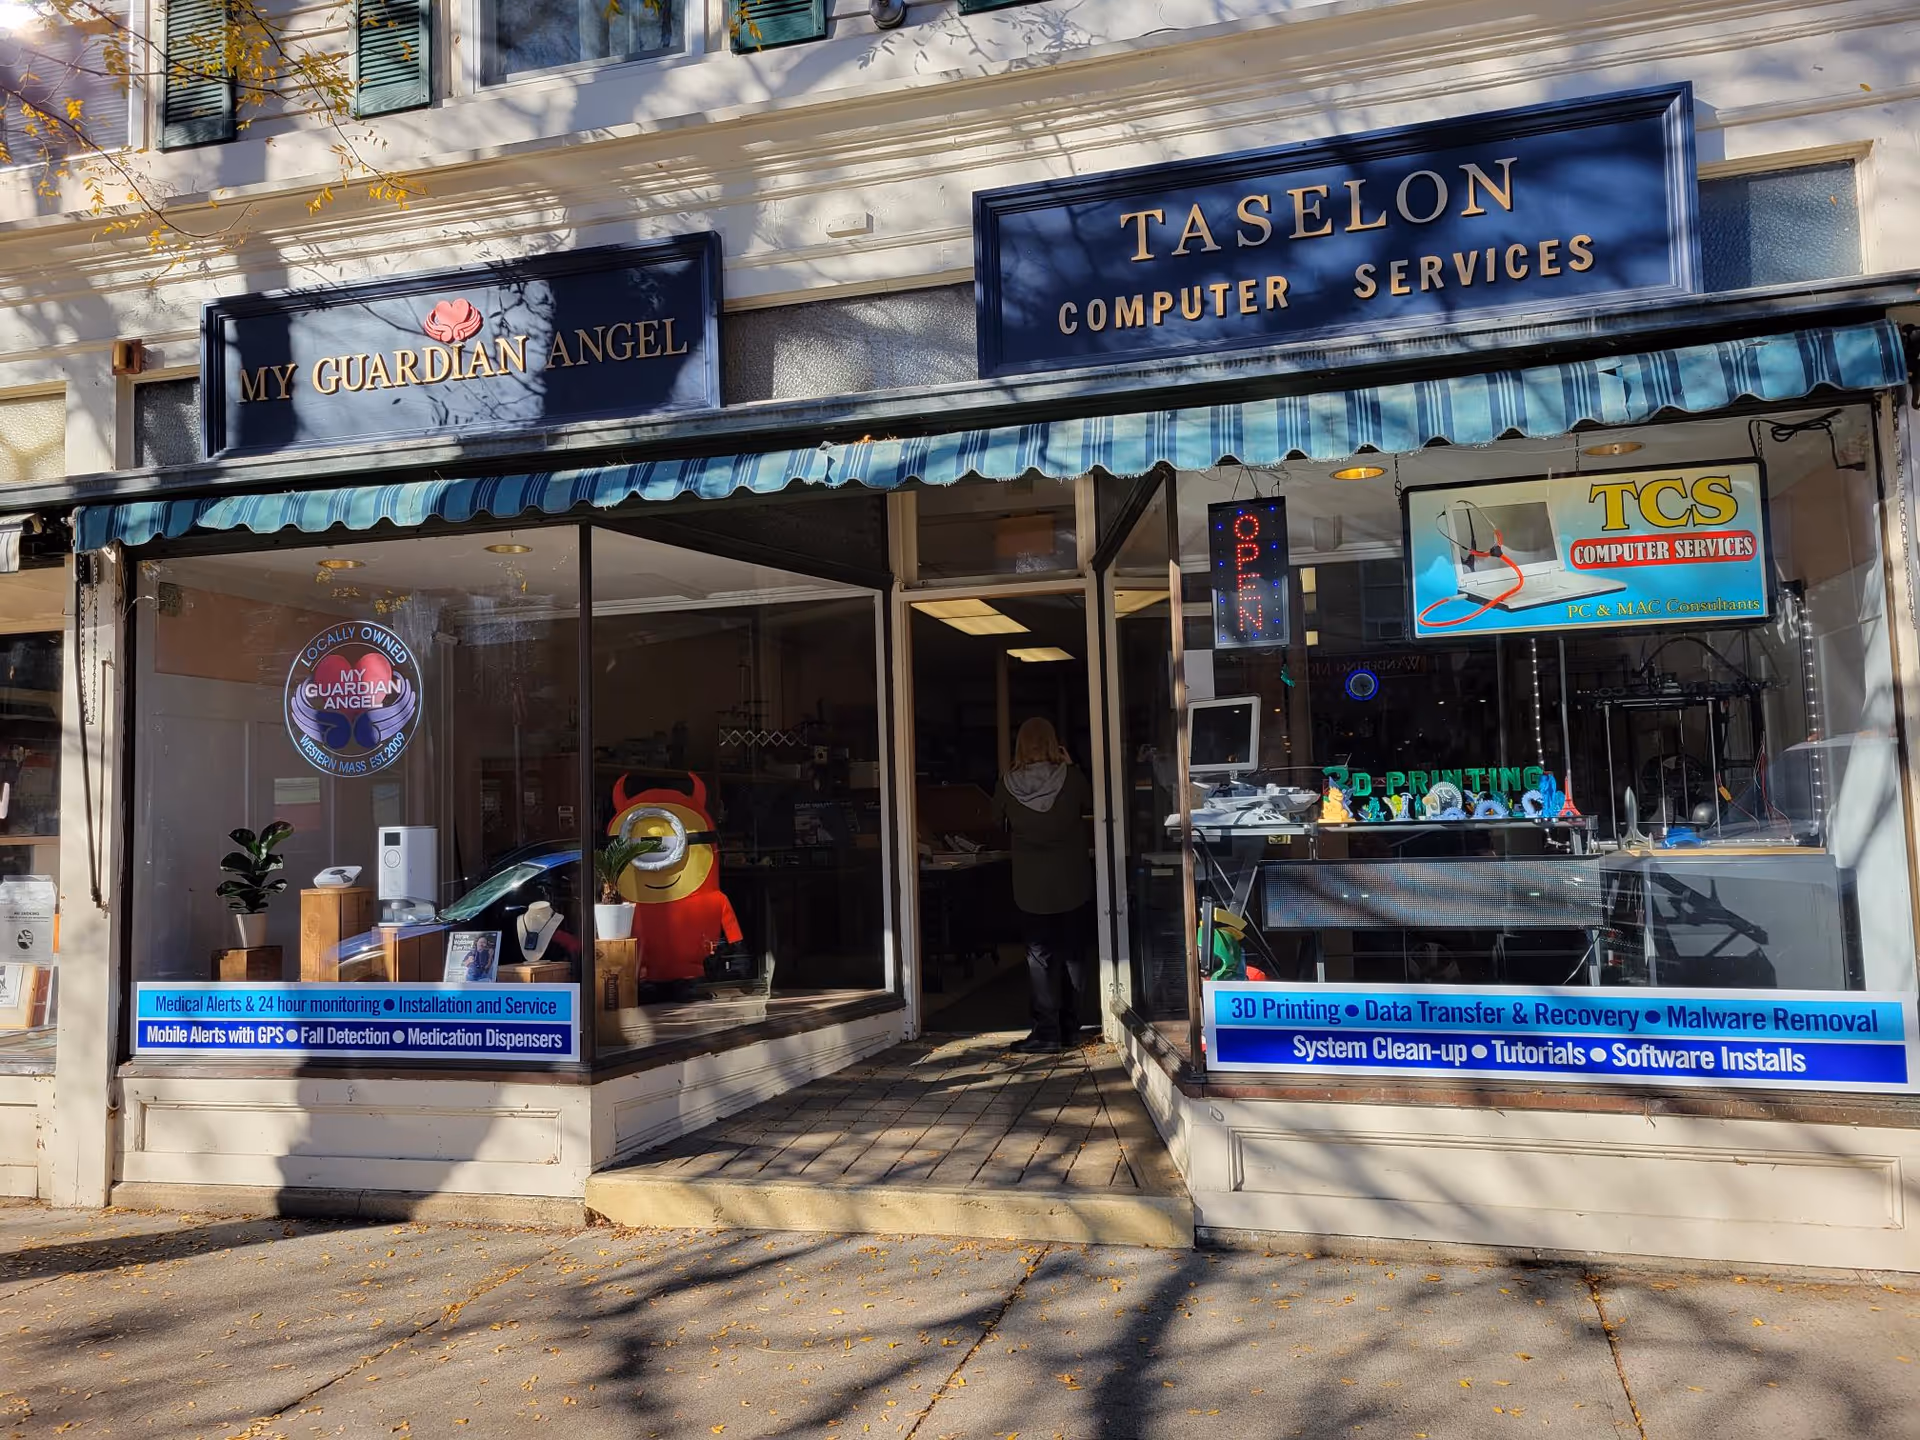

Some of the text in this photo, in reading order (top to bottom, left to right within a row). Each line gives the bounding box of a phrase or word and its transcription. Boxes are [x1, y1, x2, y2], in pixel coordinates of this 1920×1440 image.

[1120, 156, 1518, 262] TASELON
[1058, 234, 1594, 335] COMPUTER SERVICES
[238, 317, 688, 403] MY GUARDIAN ANGEL
[1589, 475, 1738, 531] TCS
[1573, 536, 1754, 565] COMPUTER SERVICES
[1233, 514, 1262, 632] OPEN
[1567, 597, 1760, 618] PC & MAC Consultants
[301, 626, 407, 668] LOCALLY OWNED
[305, 679, 401, 698] GUARDIAN
[340, 669, 366, 682] MY
[324, 695, 383, 709] ANGEL
[300, 733, 337, 772] WESTERN
[339, 760, 367, 773] MASS
[384, 731, 405, 759] 2009
[1386, 766, 1545, 795] PRINTING
[156, 995, 557, 1016] Medical Alerts & 24 hour monitoring Installation and Service
[1231, 997, 1878, 1033] 3D Printing Data Transfer & Recovery Malware Removal
[147, 1026, 563, 1050] Mobile Alerts with GPS Fall Detection Medication Dispensers
[1293, 1034, 1807, 1073] System Clean-up Tutorials Software Installs
